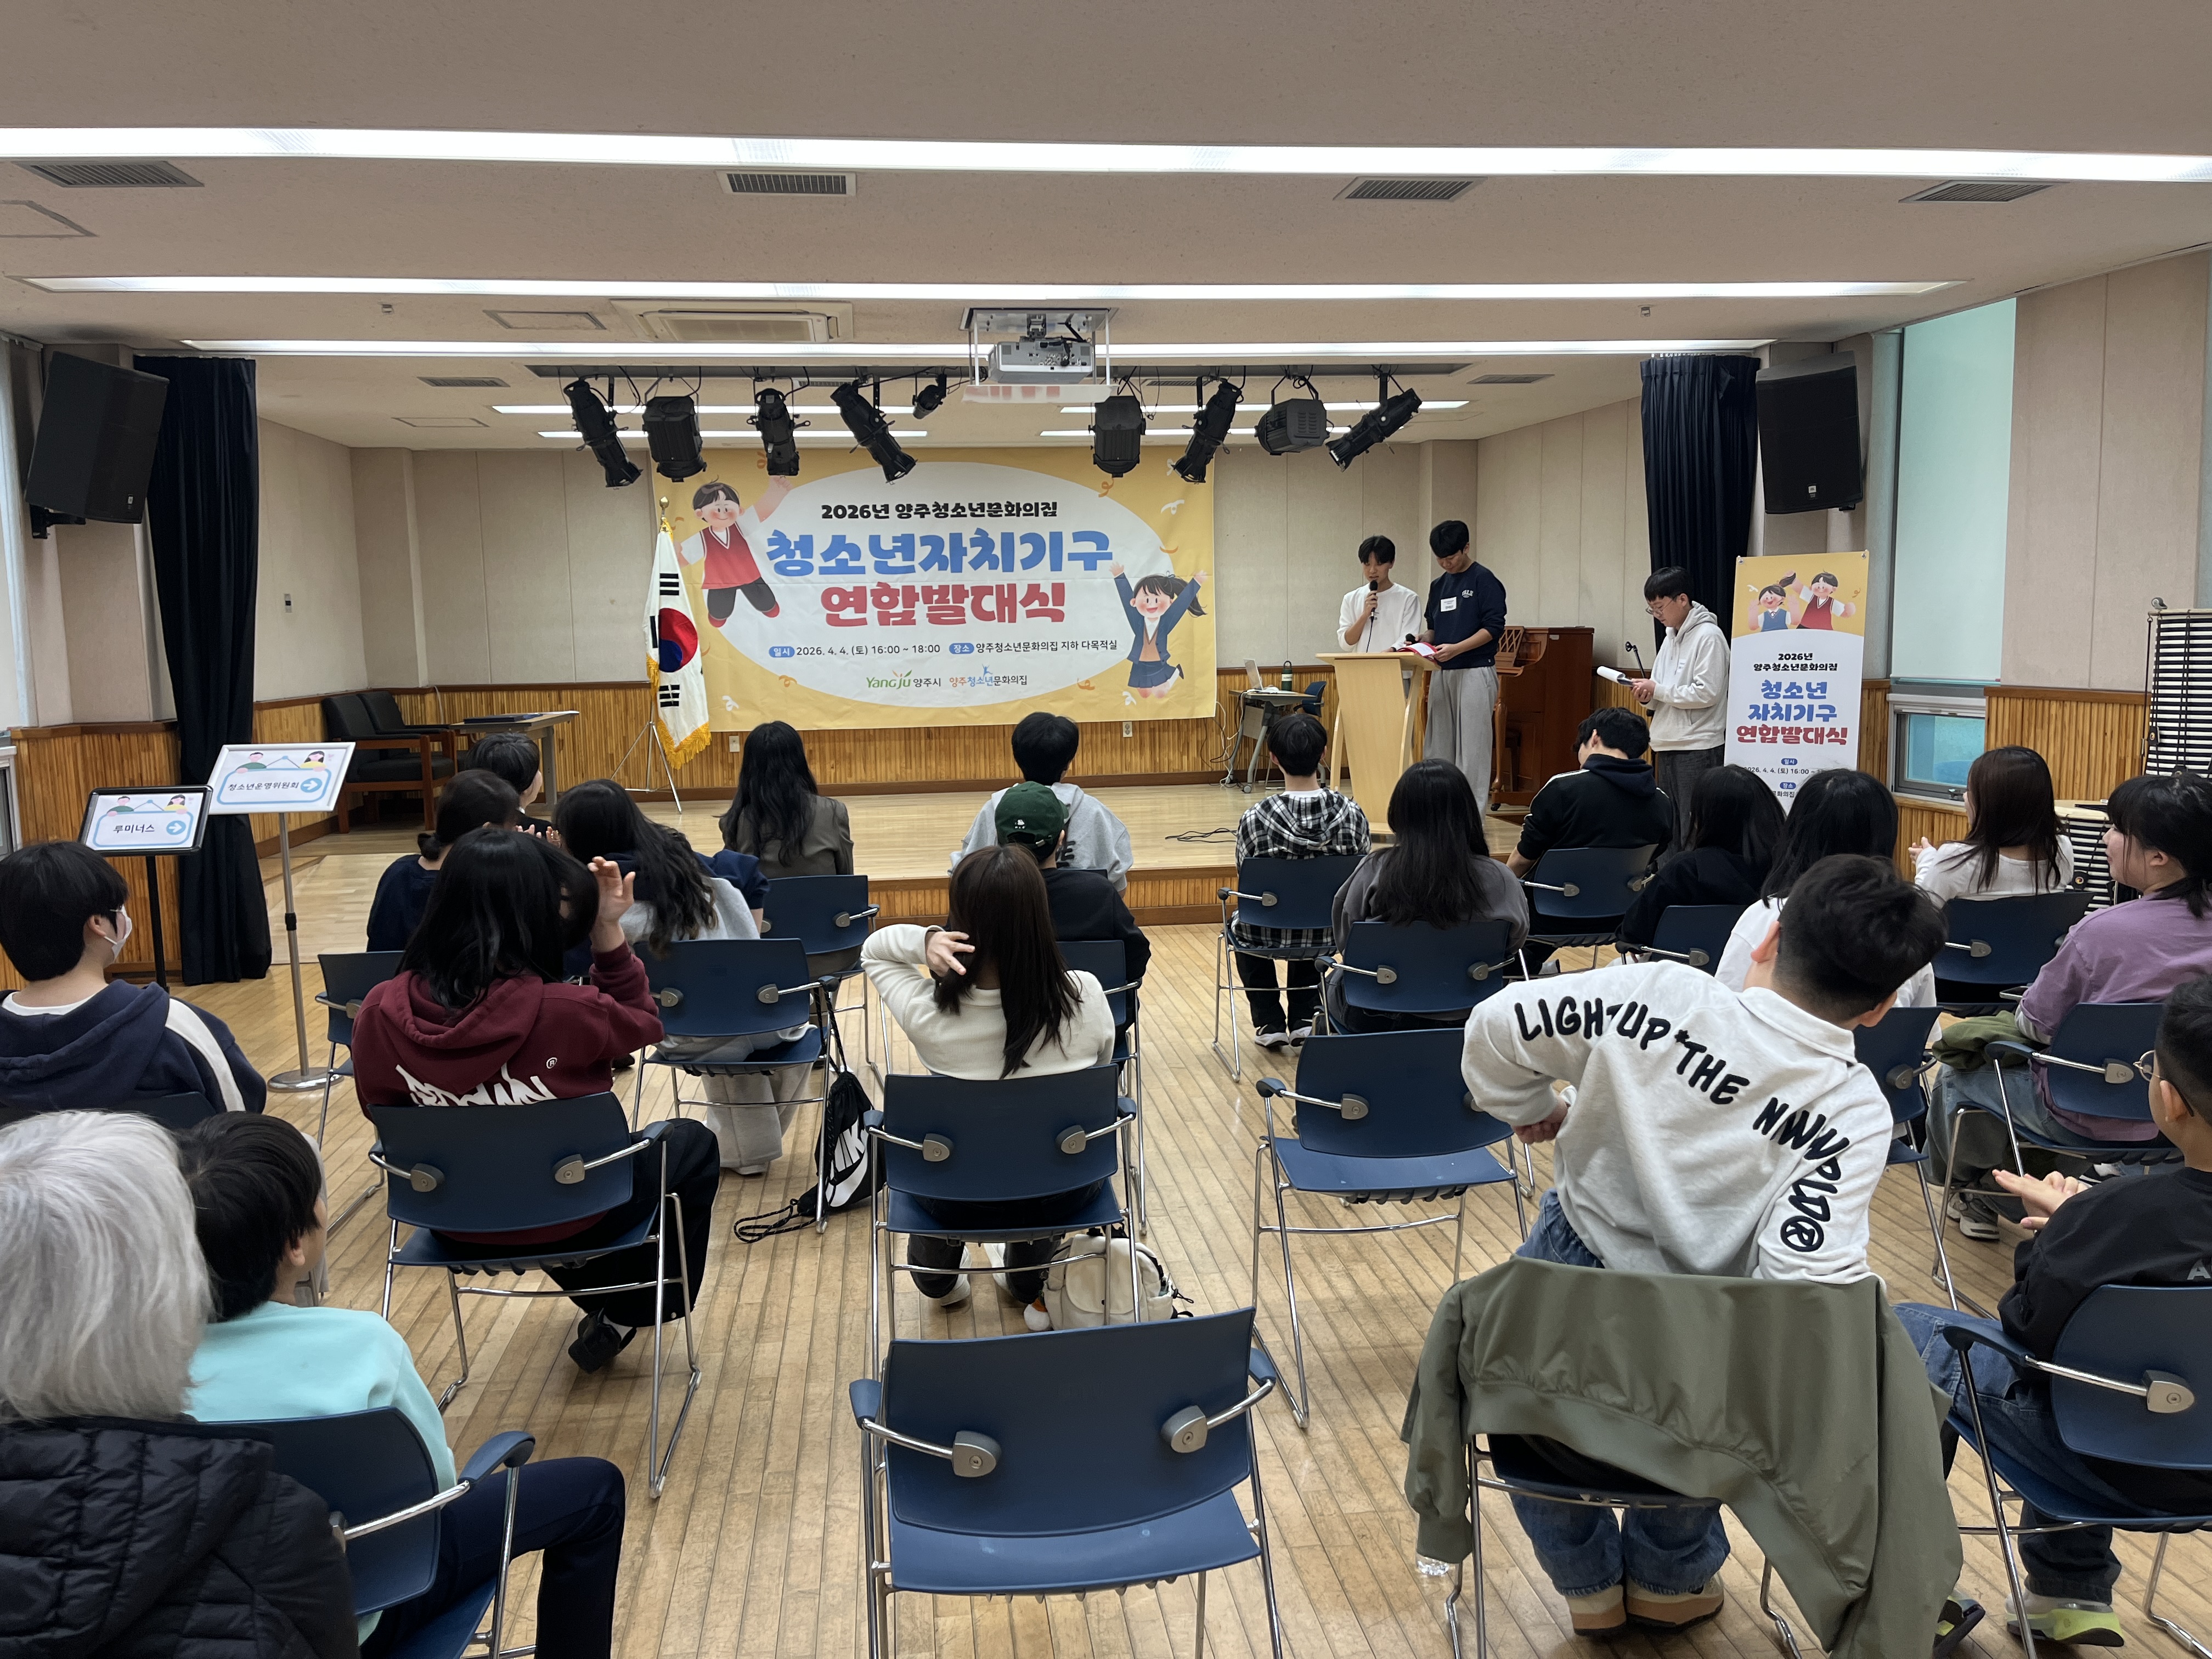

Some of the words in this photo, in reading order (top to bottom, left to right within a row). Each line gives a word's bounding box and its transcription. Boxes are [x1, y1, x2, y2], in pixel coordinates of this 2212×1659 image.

[821, 503, 889, 520] 2026년
[895, 501, 1057, 518] 양주청소년문화의집
[766, 527, 1113, 577] 청소년자치기구
[820, 582, 1065, 627] 연합발대식
[773, 647, 790, 657] 일시
[796, 646, 825, 656] 2026.
[827, 646, 837, 656] 4.
[839, 646, 849, 656] 4.
[851, 645, 868, 656] (토)
[871, 645, 900, 654] 16:00
[912, 644, 940, 653] 18:00
[953, 644, 970, 653] 장소
[976, 641, 1058, 653] 양주청소년문화의집
[1061, 640, 1079, 651] 지하
[1081, 640, 1118, 651] 다목적실
[1778, 652, 1813, 661] 2026년
[1753, 662, 1838, 672] 양주청소년문화의집
[913, 678, 941, 688] 양주시
[949, 675, 1028, 687] 양주청소년문화의집
[1760, 679, 1827, 699] 청소년
[1747, 702, 1837, 723] 자치기구
[1736, 723, 1848, 746] 연합발대식
[228, 781, 300, 792] 청소년운영위원회
[112, 823, 155, 834] 루미너스
[1616, 1001, 1671, 1051] UP
